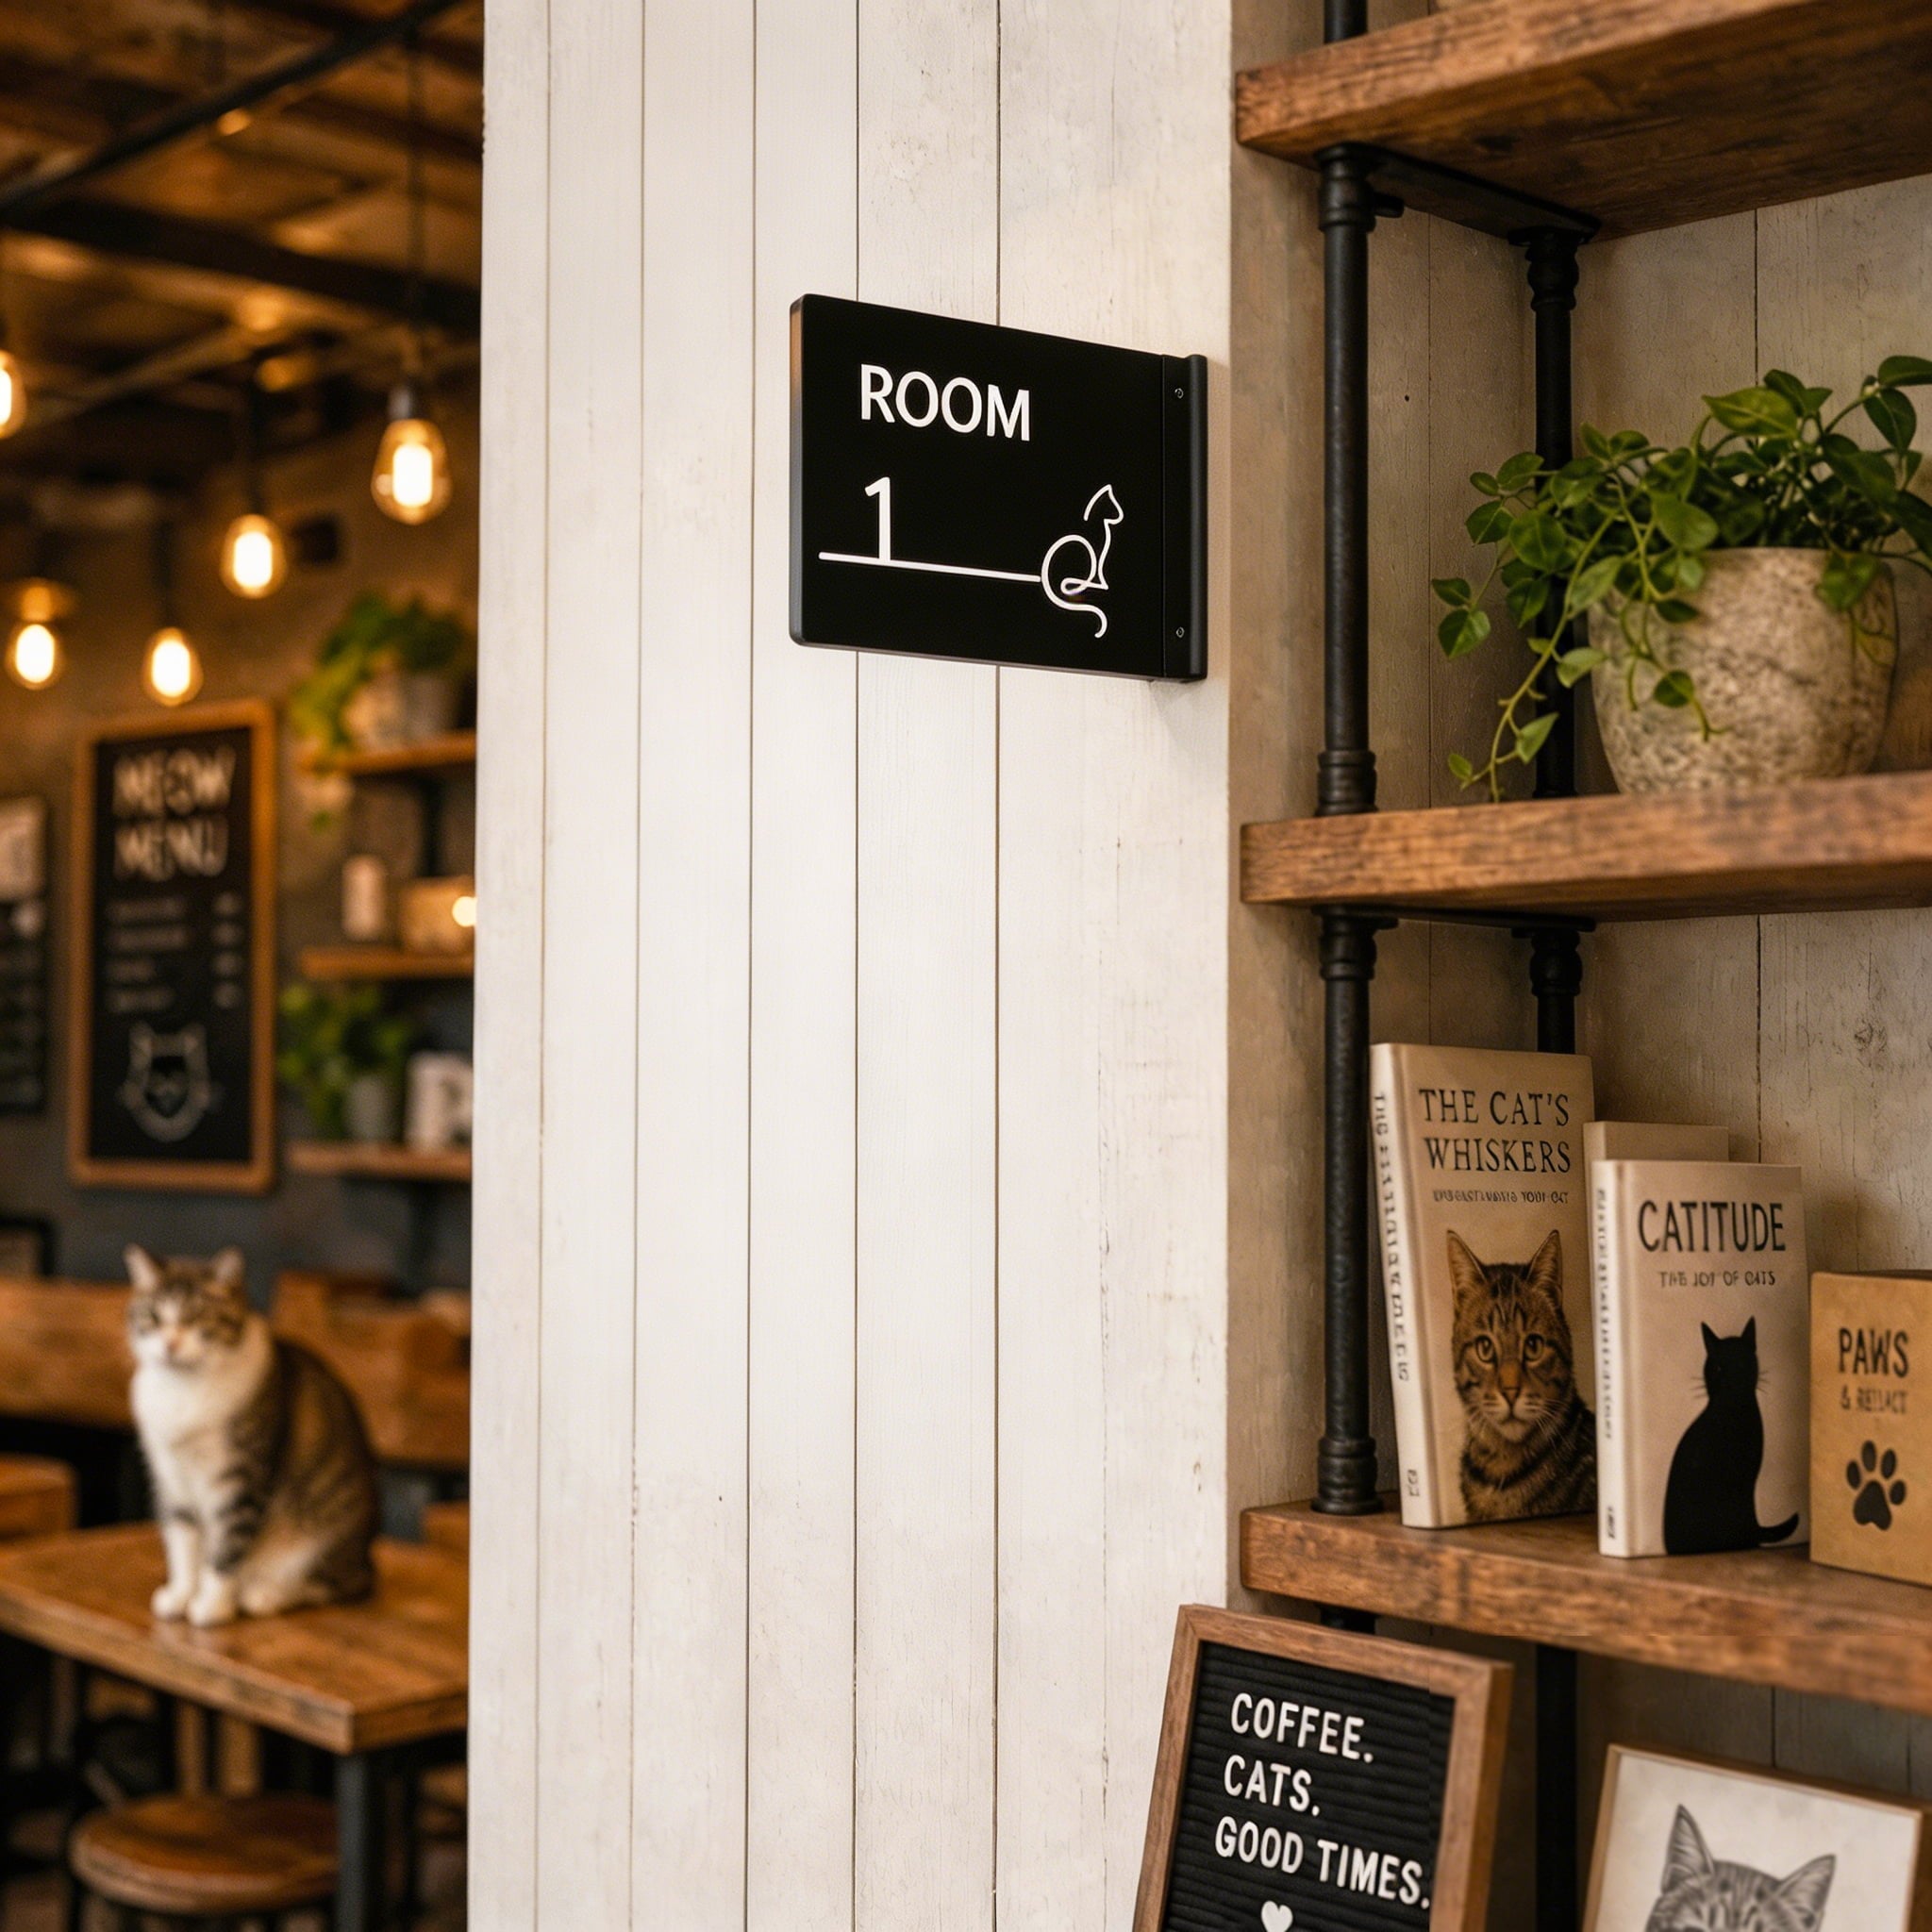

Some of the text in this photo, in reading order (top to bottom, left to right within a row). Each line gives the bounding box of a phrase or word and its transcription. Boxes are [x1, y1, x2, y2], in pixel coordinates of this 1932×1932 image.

[860, 363, 1030, 441] ROOM
[865, 476, 891, 563] 1
[113, 816, 227, 880] MENU
[1419, 1089, 1569, 1126] THE CAT'S
[1424, 1138, 1572, 1174] WHISKERS
[1638, 1200, 1786, 1252] CATITUDE
[1839, 1327, 1909, 1378] PAWS
[1231, 1692, 1374, 1763] COFFEE.
[1224, 1755, 1320, 1816] CATS.
[1215, 1816, 1430, 1909] GOOD TIMES.
